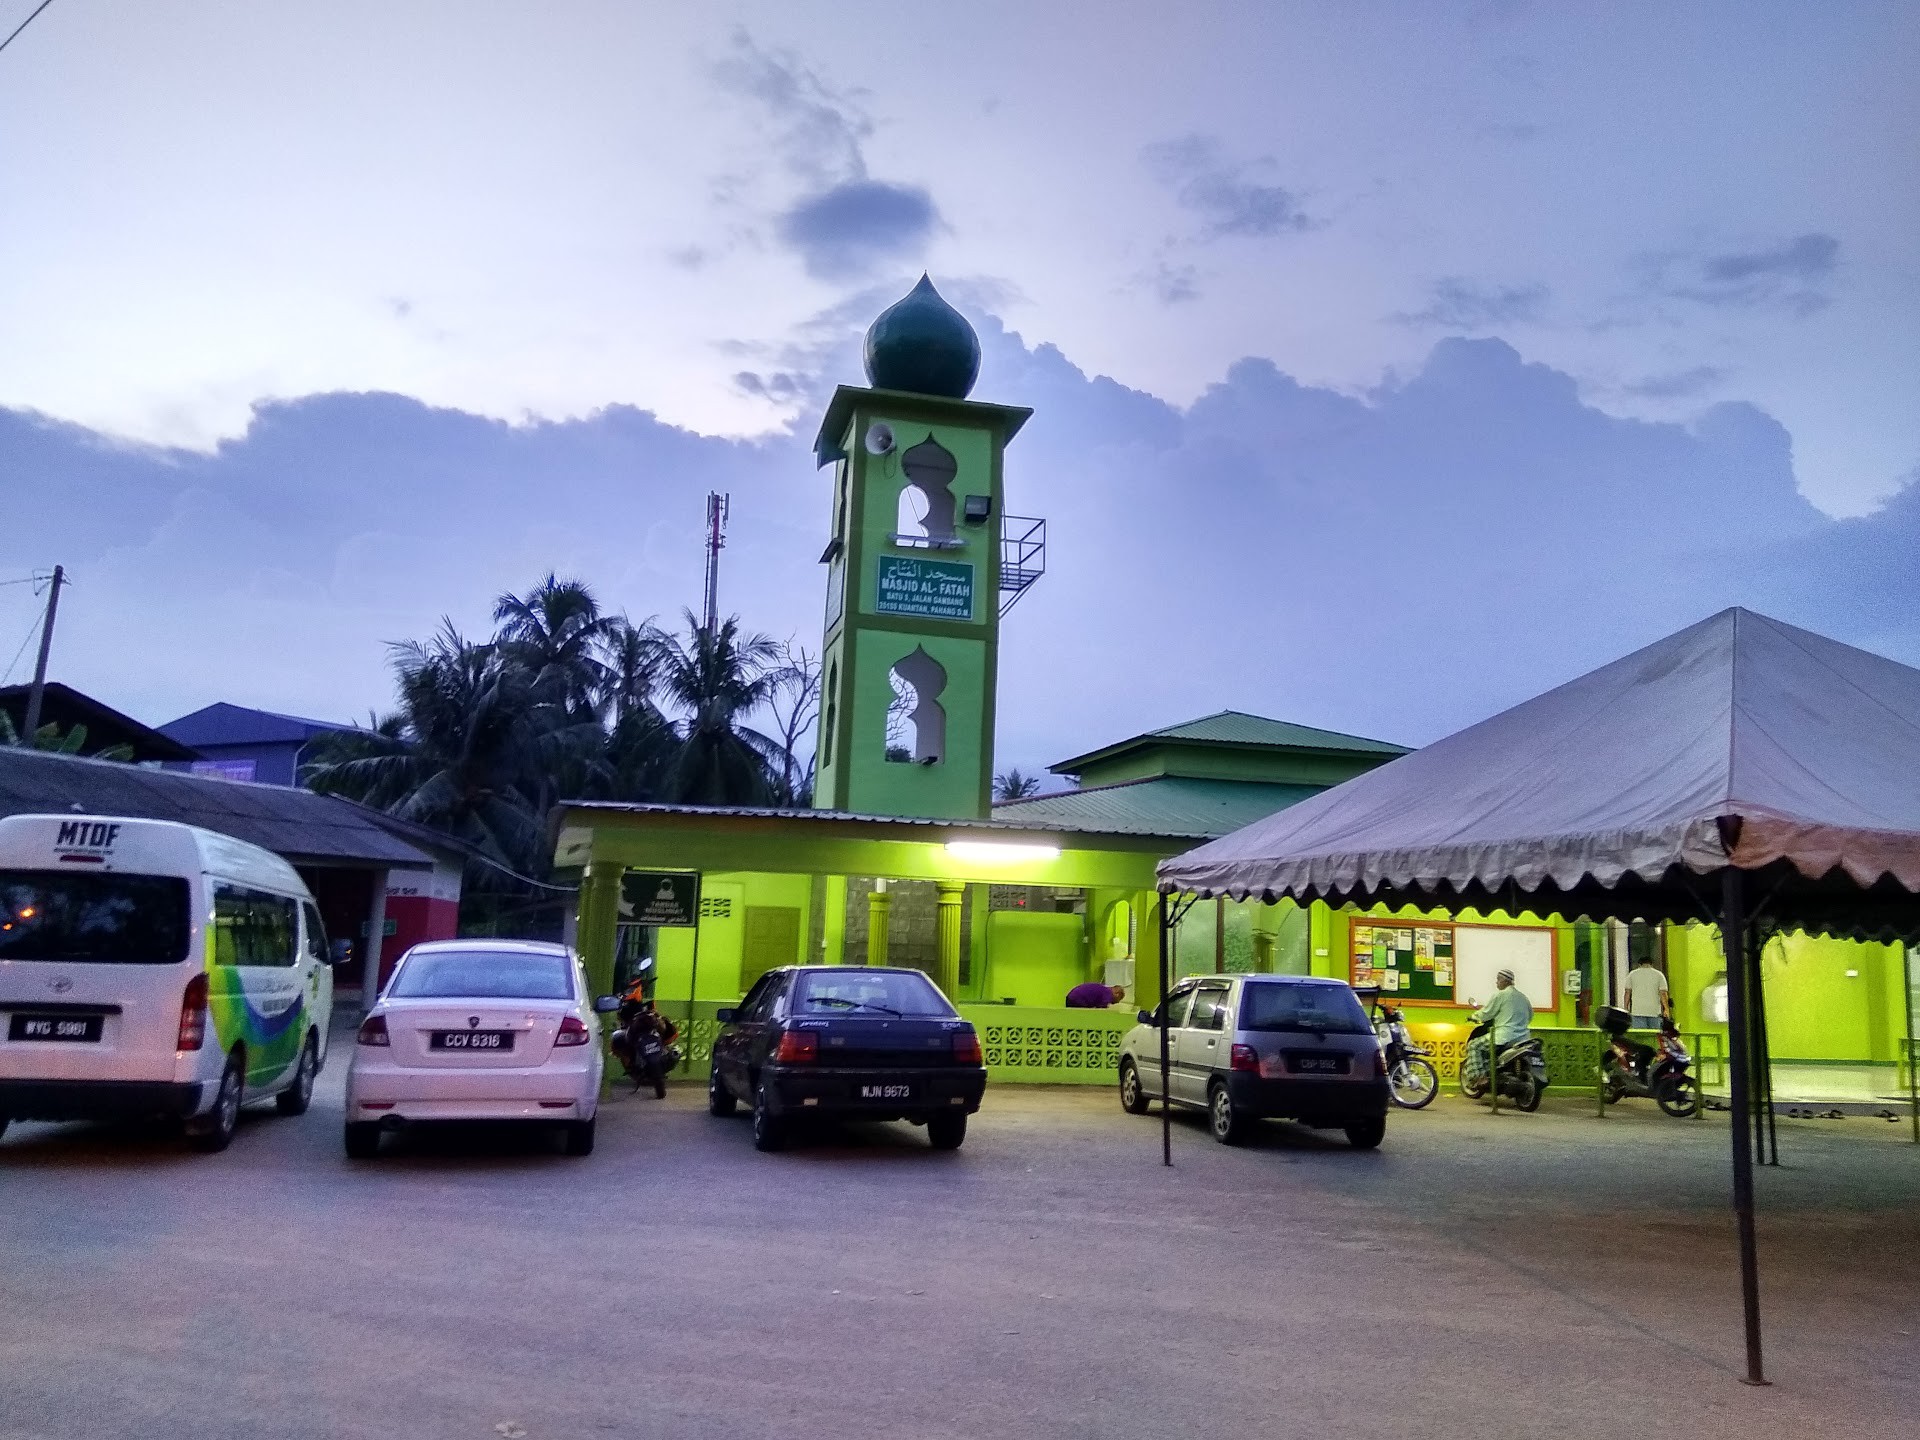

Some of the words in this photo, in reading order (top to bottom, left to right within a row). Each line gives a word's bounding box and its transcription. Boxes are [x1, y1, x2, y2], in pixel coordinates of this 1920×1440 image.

[925, 569, 966, 582] مسجد
[881, 578, 918, 593] MASJID
[939, 583, 970, 597] FATAH
[887, 592, 903, 601] BATU
[911, 594, 933, 604] JALAN
[931, 606, 956, 615] PAHANG
[56, 821, 122, 847] MTDF
[445, 1033, 469, 1047] CCV
[862, 1085, 882, 1098] WJN
